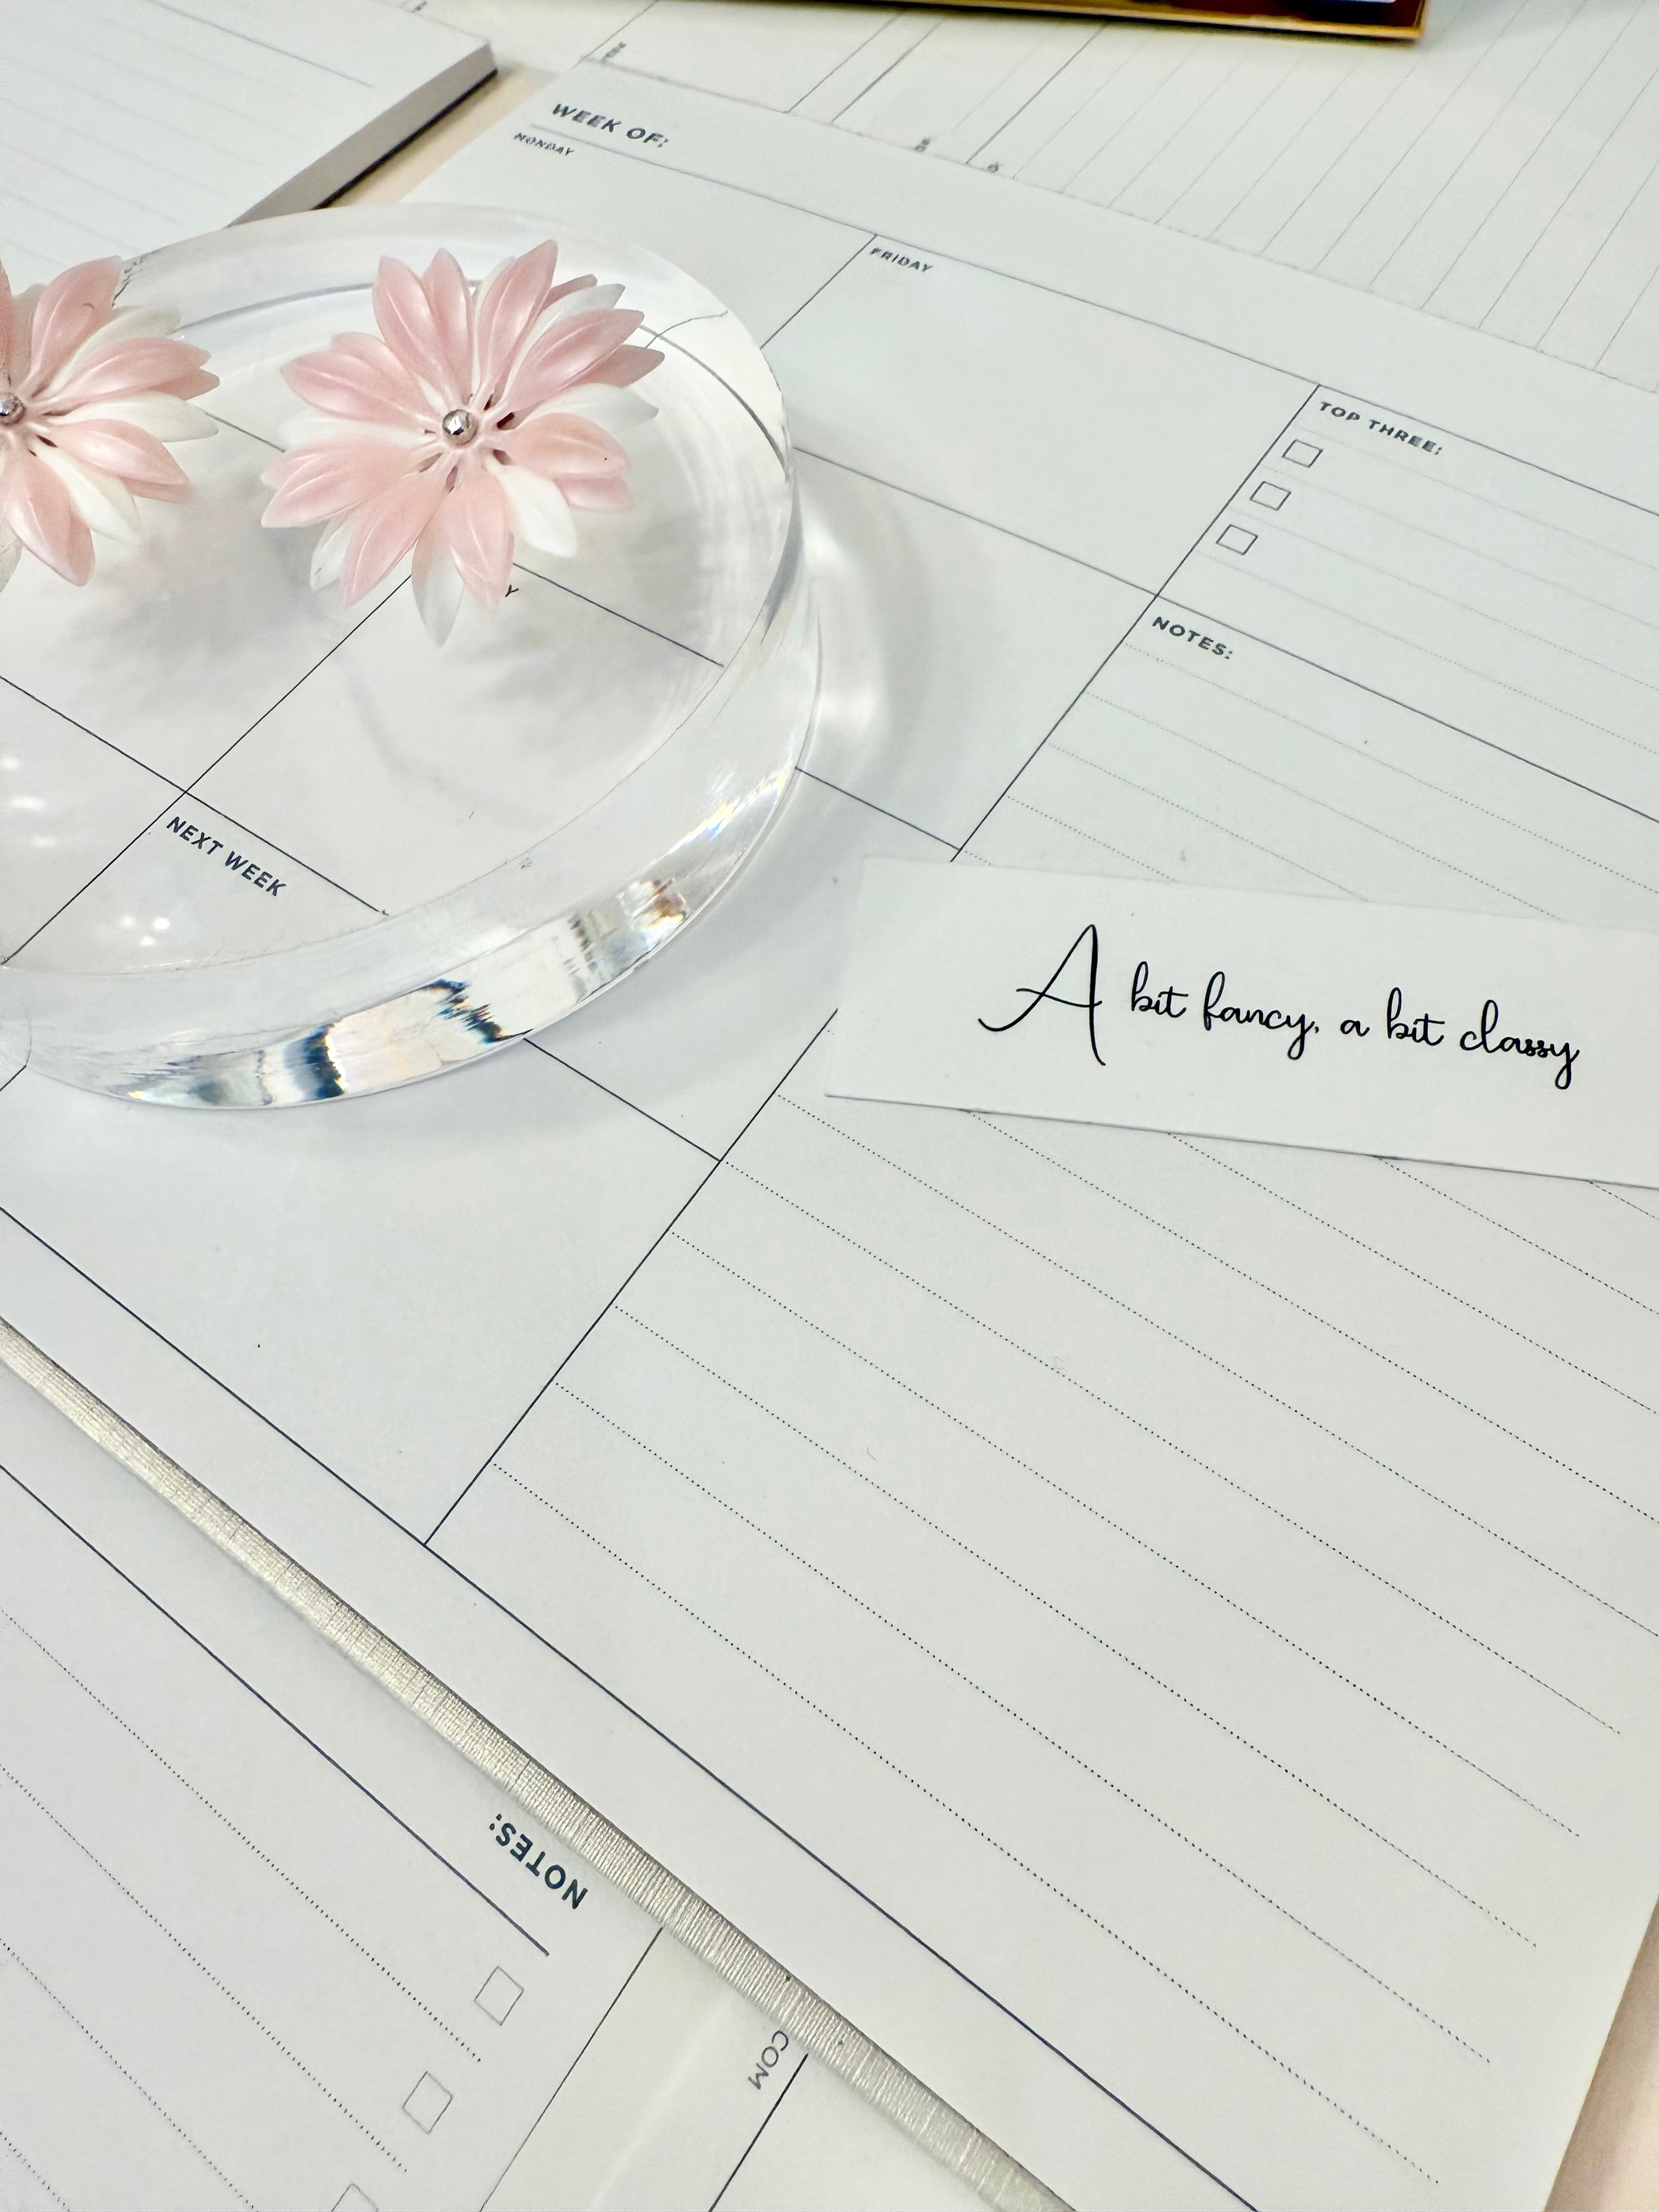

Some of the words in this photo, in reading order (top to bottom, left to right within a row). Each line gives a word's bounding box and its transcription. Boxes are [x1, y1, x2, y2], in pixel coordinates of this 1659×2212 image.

[552, 103, 622, 133] WEEK
[870, 247, 933, 272] FRIDAY
[1319, 401, 1361, 421] TOP
[1369, 419, 1443, 455] THREE:
[1152, 616, 1234, 659] NOTES:
[166, 816, 224, 855] NEXT
[225, 850, 286, 896] WEEK
[978, 924, 1106, 1066] A
[1131, 961, 1189, 1018] bit
[1340, 1019, 1370, 1037] a
[1387, 987, 1446, 1046] bit
[1459, 1000, 1580, 1090] classy
[489, 1813, 588, 1910] NOTES:
